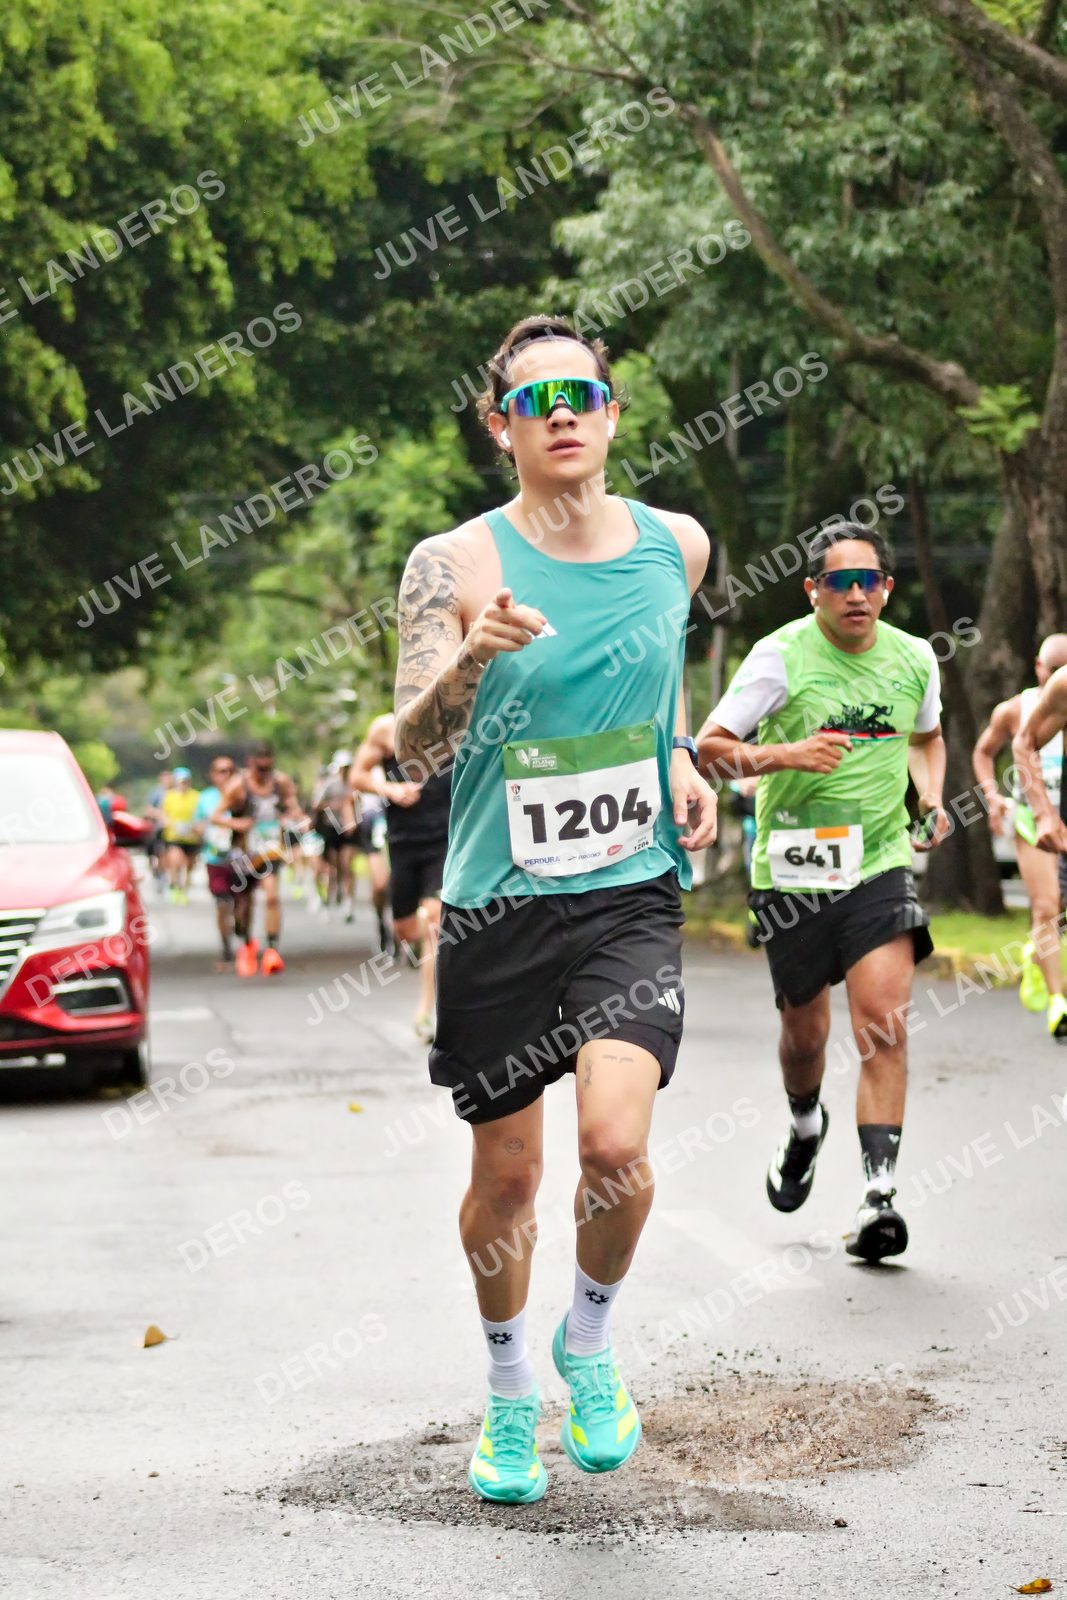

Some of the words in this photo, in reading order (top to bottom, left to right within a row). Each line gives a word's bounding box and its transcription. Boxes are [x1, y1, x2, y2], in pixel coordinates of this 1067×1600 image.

[522, 786, 653, 844] 1204
[524, 856, 561, 865] PERDURA
[784, 844, 842, 869] 641
